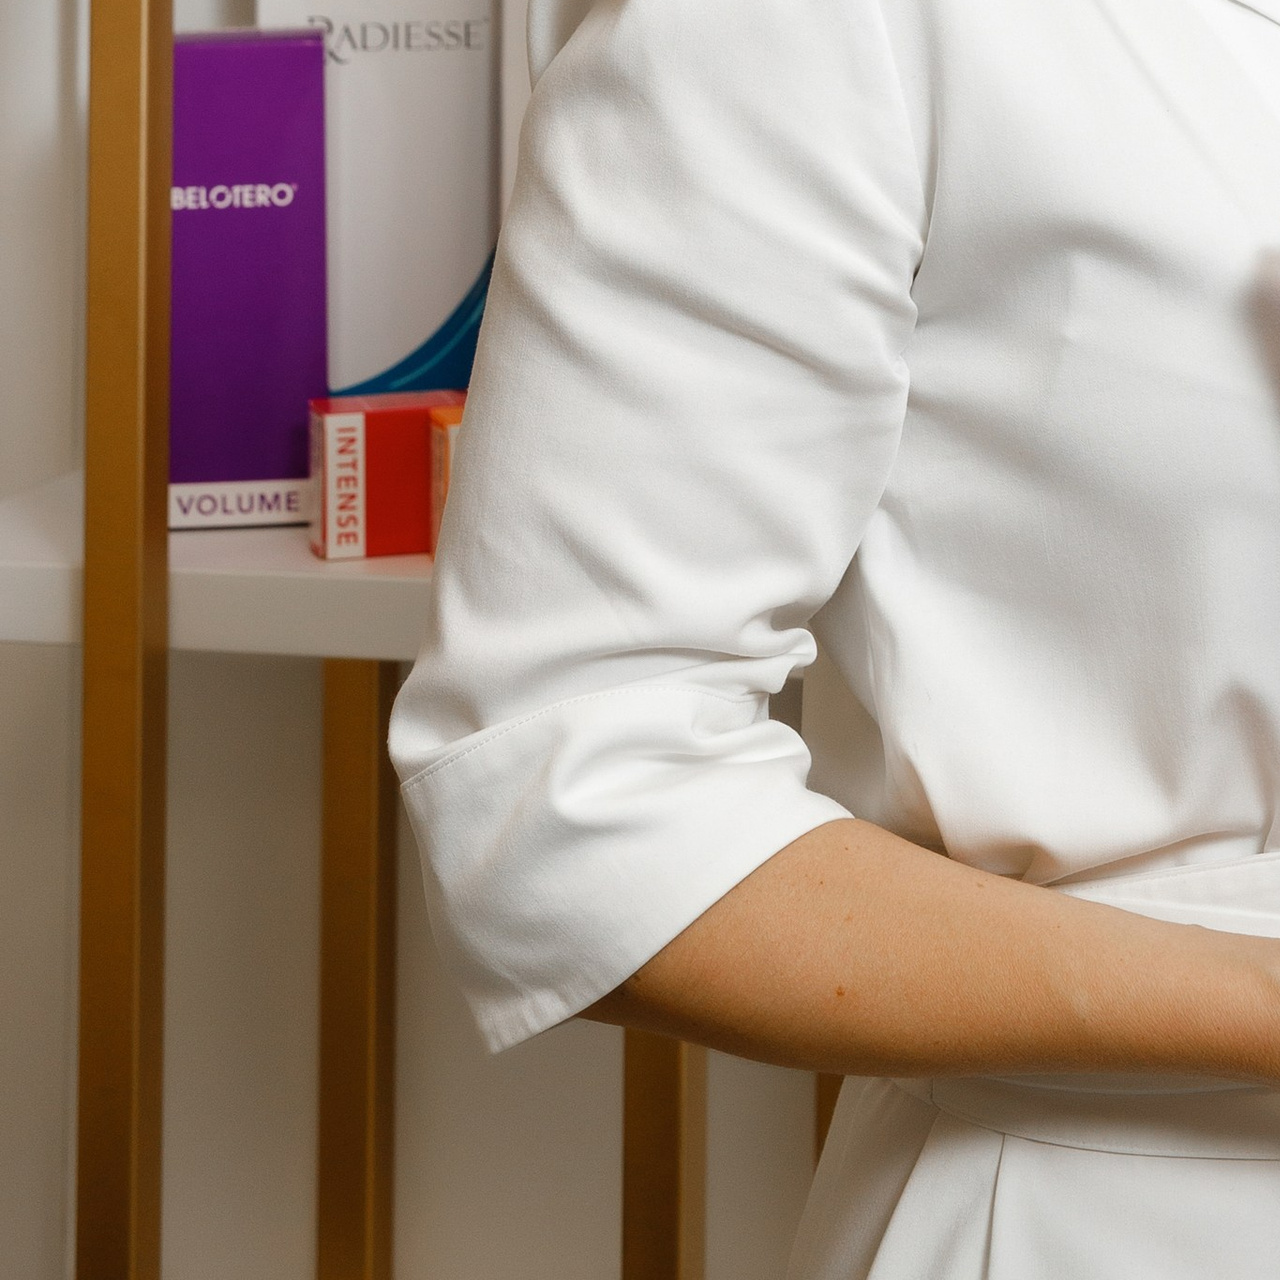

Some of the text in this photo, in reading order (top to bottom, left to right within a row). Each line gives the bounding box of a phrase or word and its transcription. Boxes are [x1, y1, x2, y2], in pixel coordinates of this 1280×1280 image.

[307, 15, 486, 65] RADIESSE
[170, 182, 295, 211] BELOTERO
[176, 490, 300, 517] VOLUME
[336, 426, 359, 546] INTENSE
